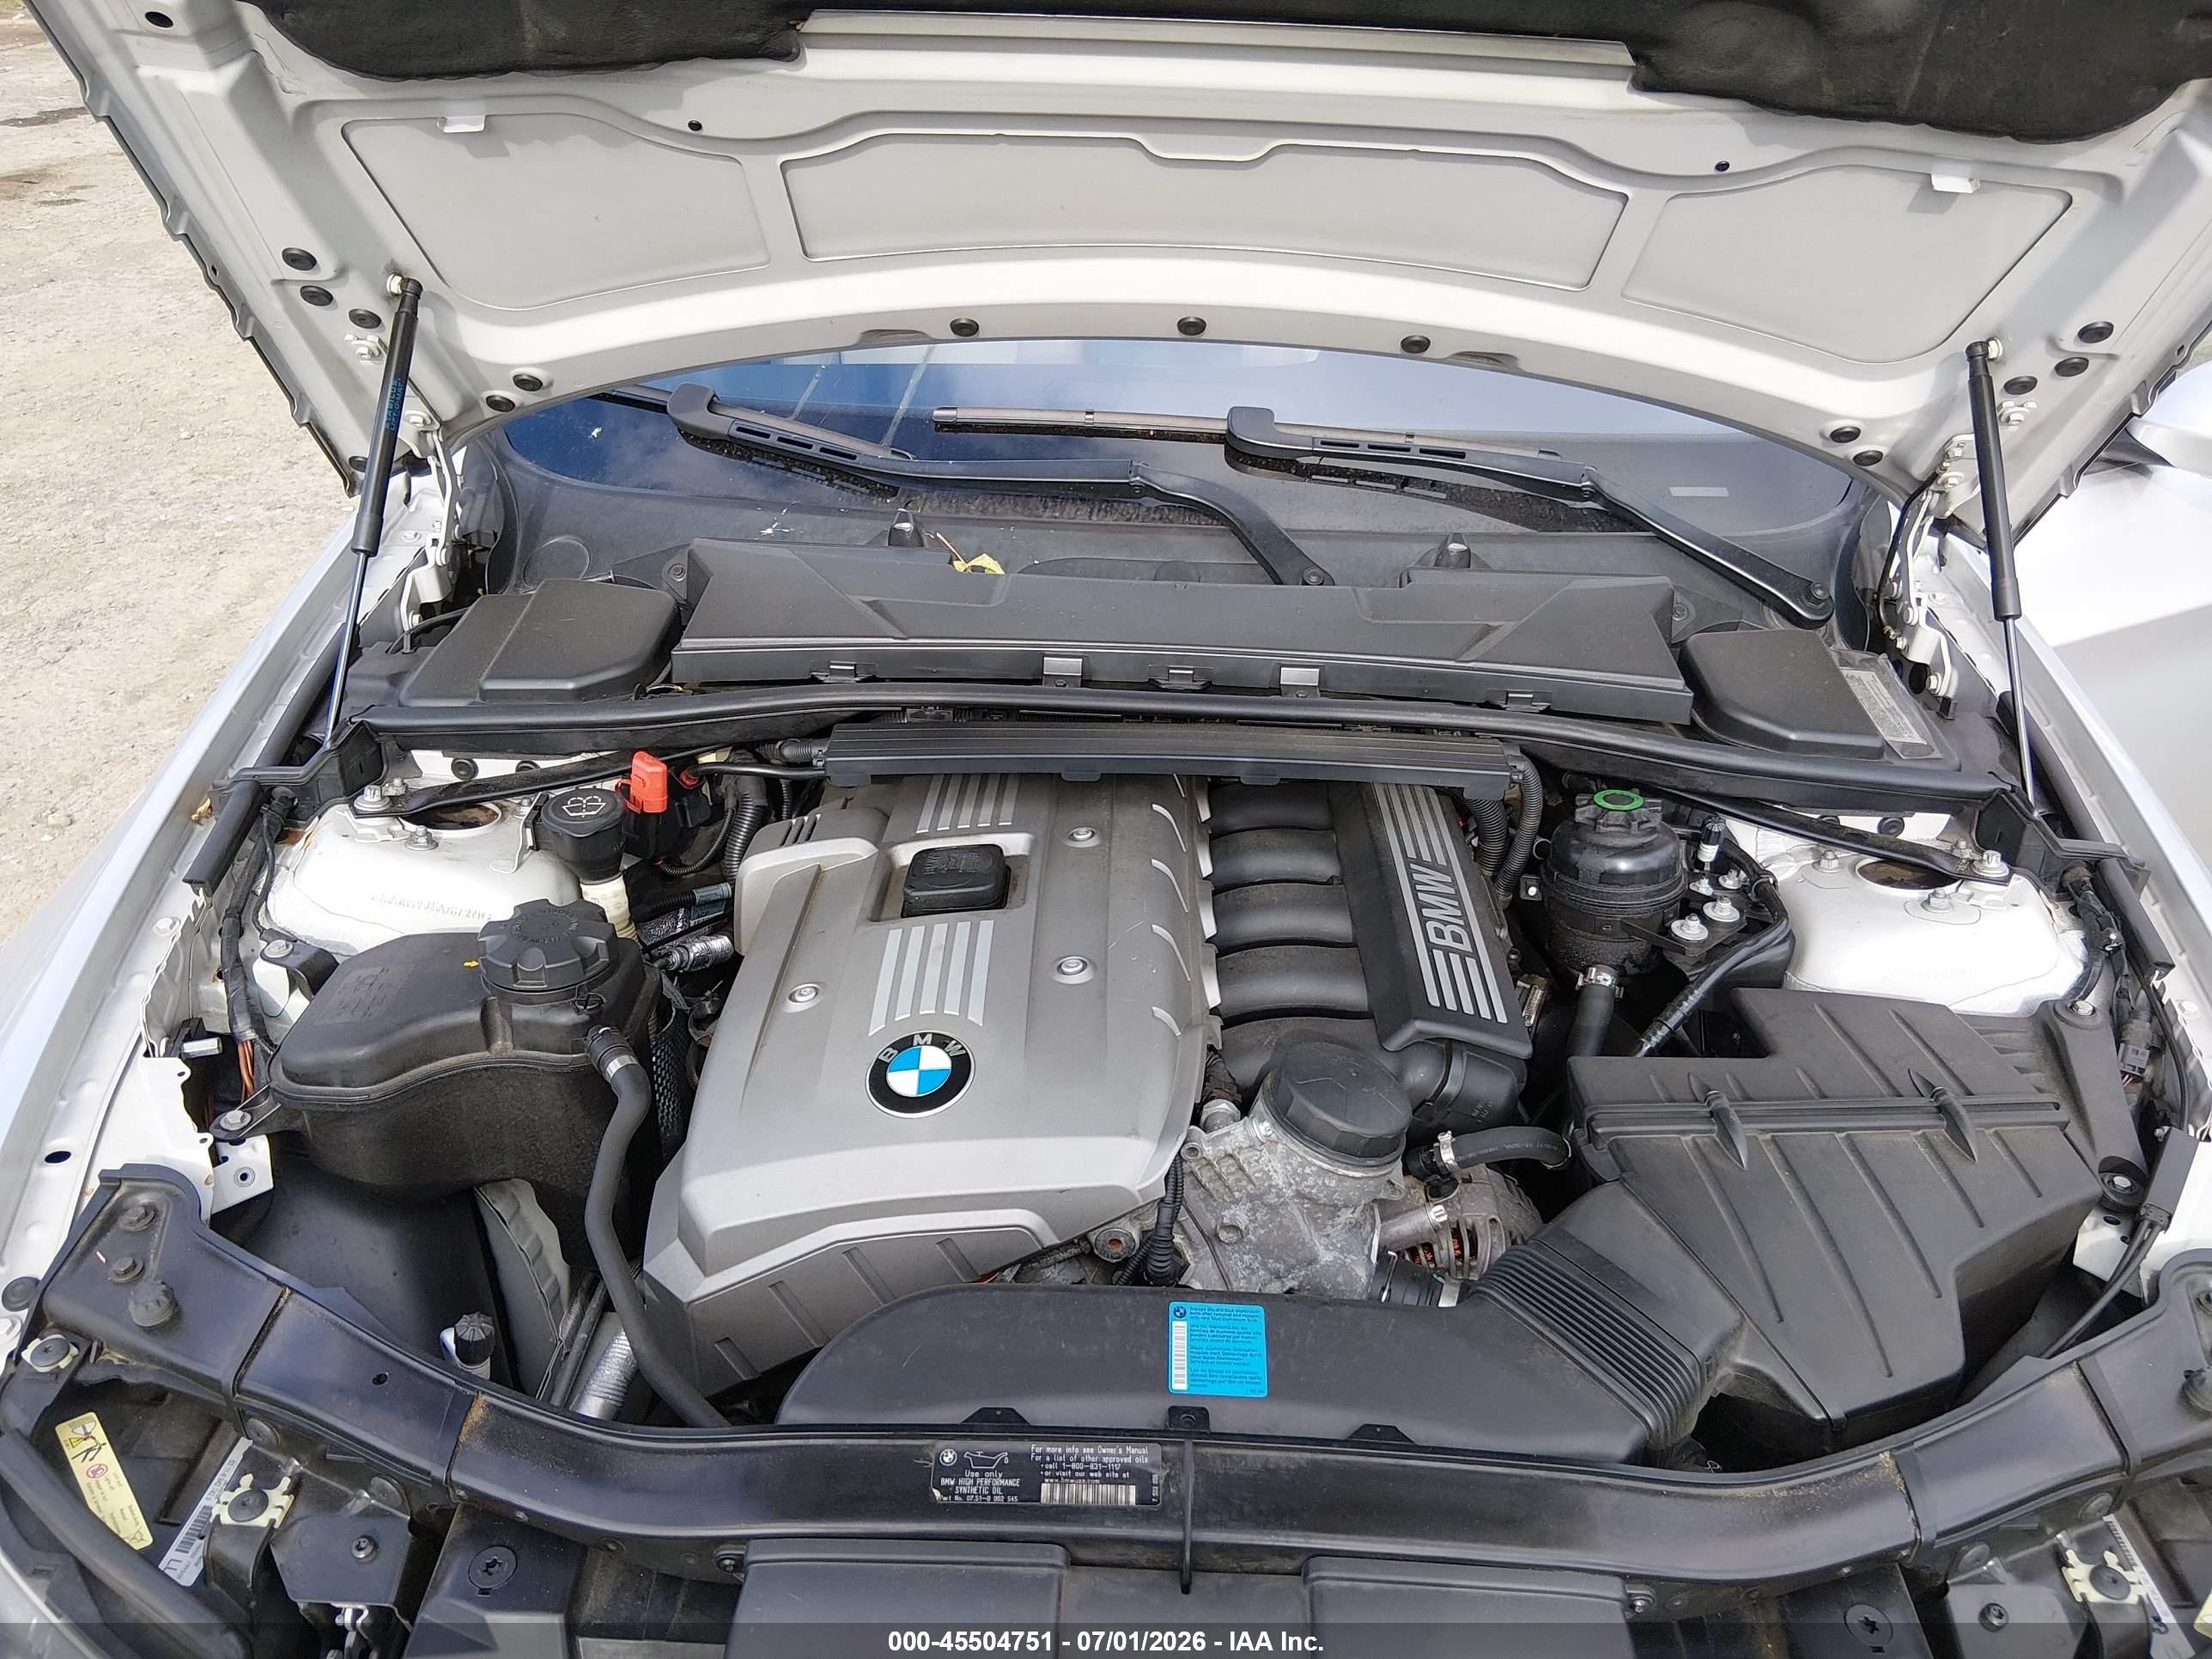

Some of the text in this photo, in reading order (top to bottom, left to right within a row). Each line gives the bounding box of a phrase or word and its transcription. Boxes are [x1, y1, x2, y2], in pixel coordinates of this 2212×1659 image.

[1409, 863, 1474, 952] BMW
[878, 1033, 966, 1063] BMW
[1031, 1444, 1042, 1453] For
[1098, 1445, 1122, 1454] Owner's
[1126, 1446, 1148, 1454] Manual
[976, 1478, 1020, 1487] PERFORMANCE
